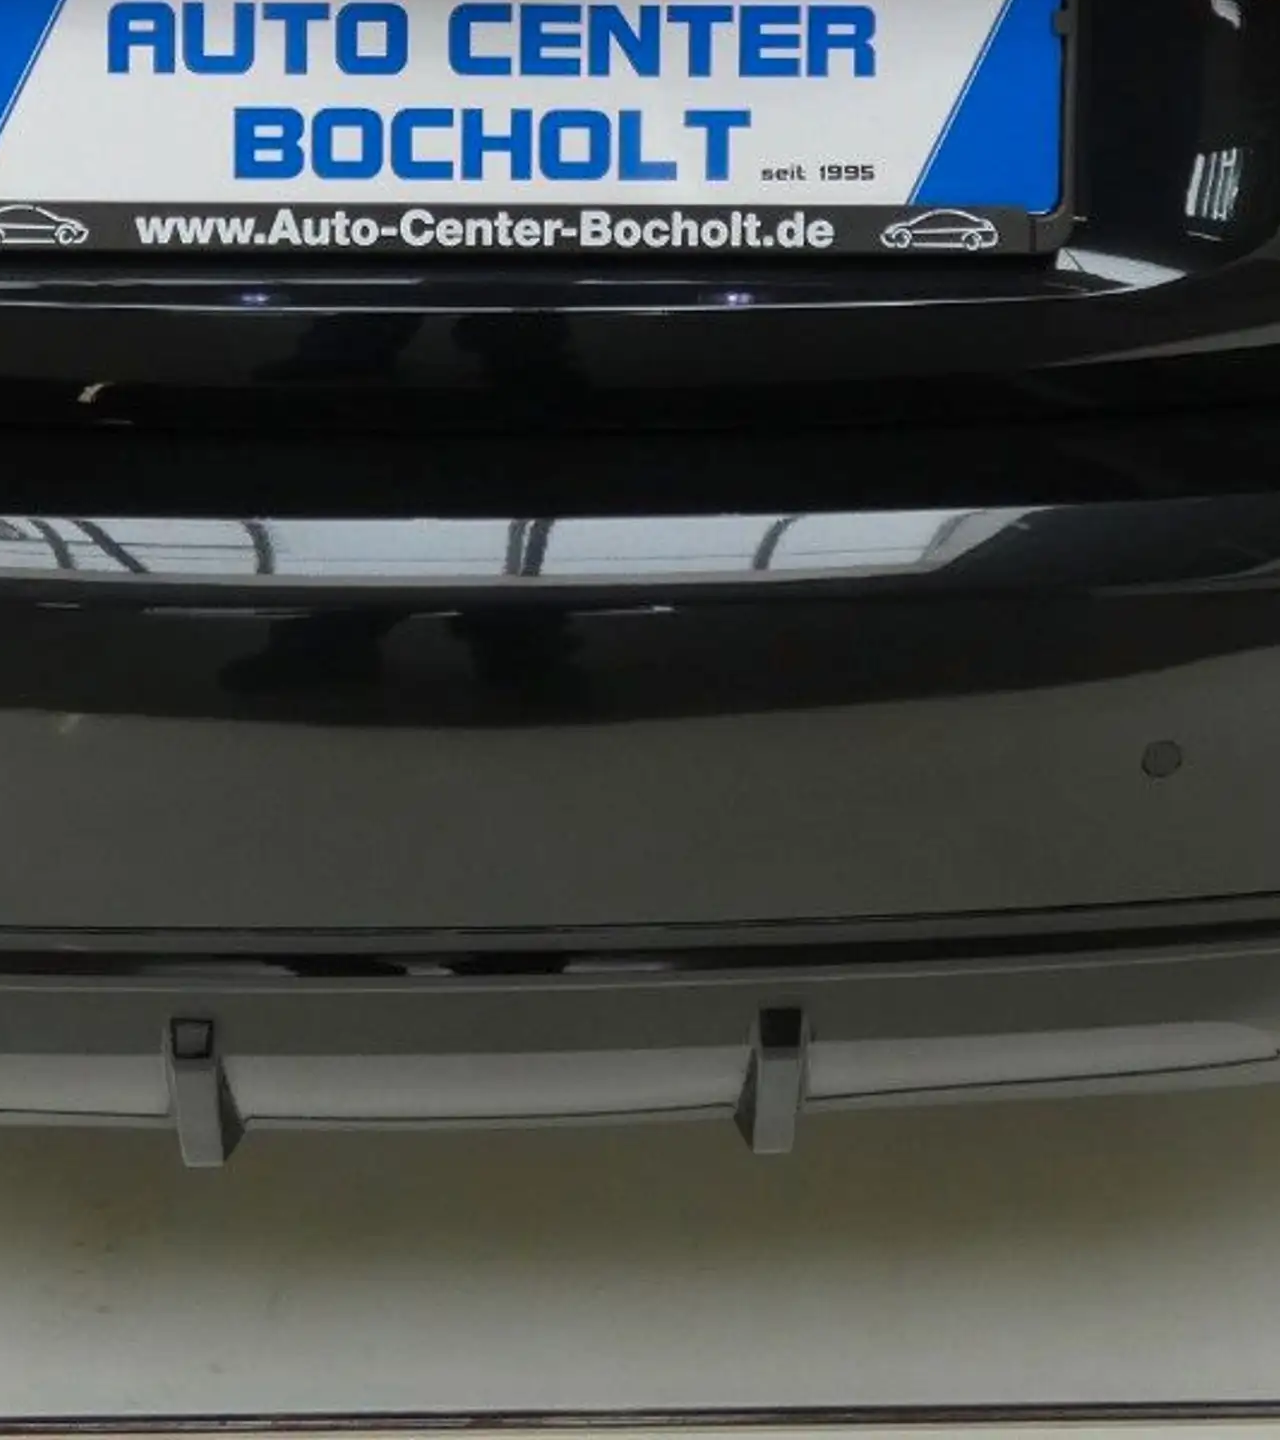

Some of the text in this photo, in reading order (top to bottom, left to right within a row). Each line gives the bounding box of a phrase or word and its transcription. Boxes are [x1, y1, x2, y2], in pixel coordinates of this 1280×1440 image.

[105, 0, 877, 80] AUTO CENTER
[232, 105, 752, 184] BOCHOLT
[761, 164, 875, 182] seit 1995
[134, 208, 836, 250] www.Auto-Center-Bocholt.de
